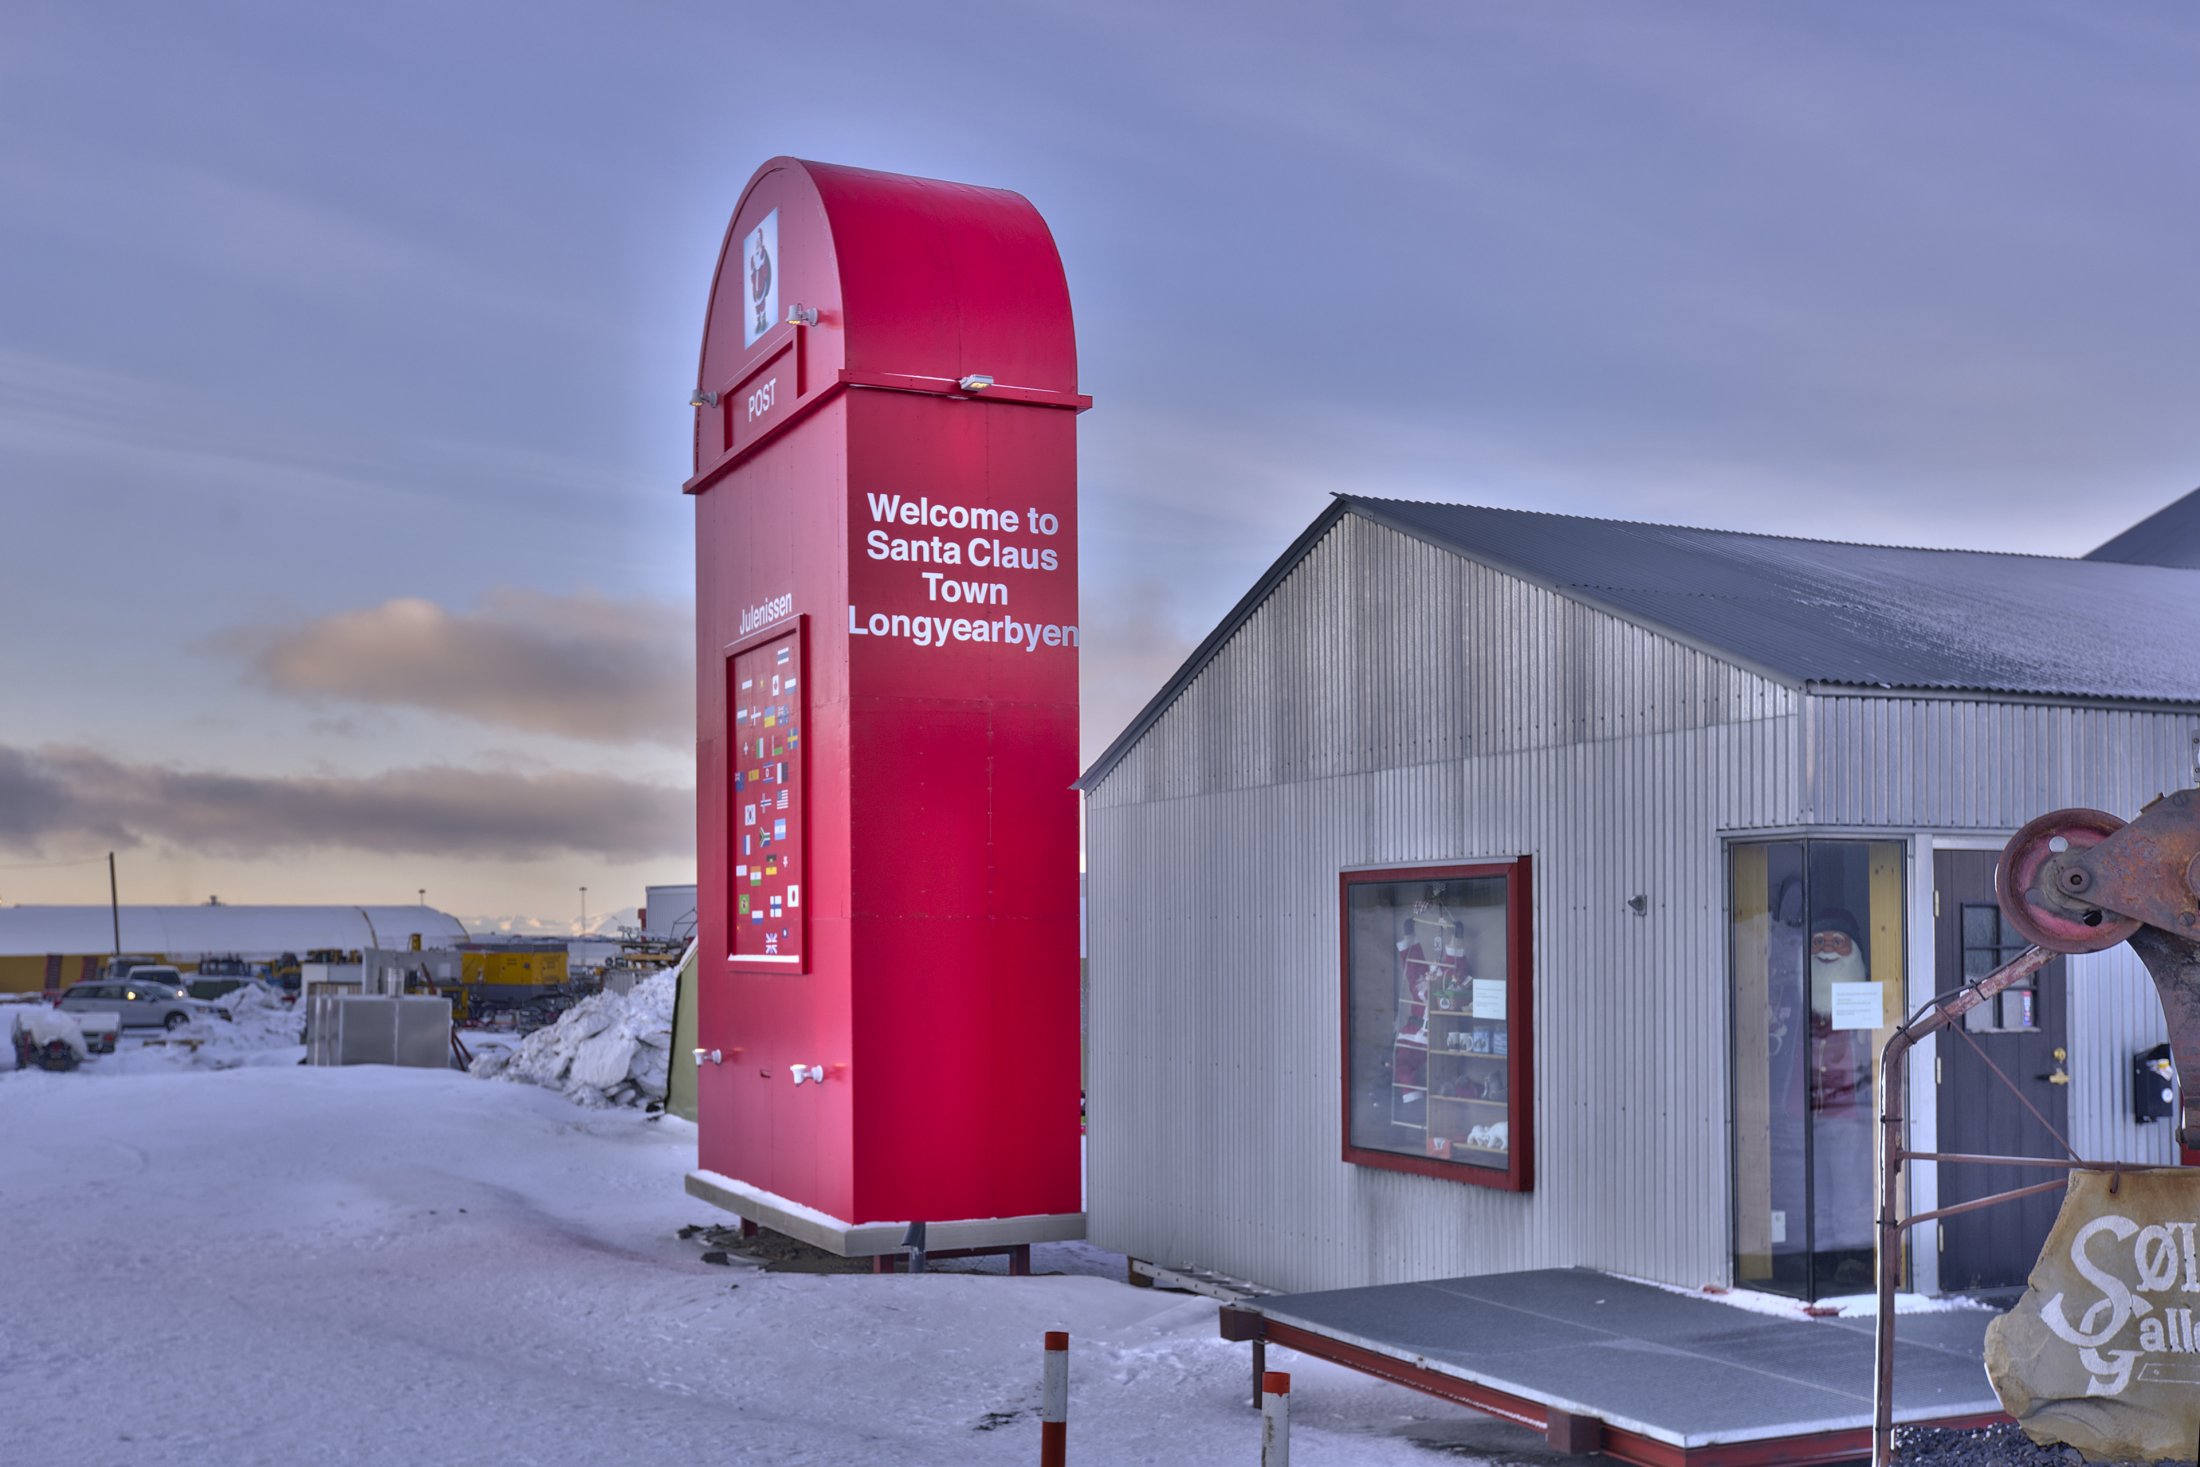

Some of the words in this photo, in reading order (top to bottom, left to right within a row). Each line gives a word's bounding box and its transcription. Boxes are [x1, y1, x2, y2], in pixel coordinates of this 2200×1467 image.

[749, 377, 777, 422] POST
[867, 492, 1020, 533] Welcome
[1027, 507, 1059, 536] to
[867, 529, 962, 565] Santa
[967, 537, 1058, 571] Claus
[922, 571, 1008, 606] Town
[739, 592, 793, 635] Julenissen
[848, 605, 1080, 653] Longyearbyen
